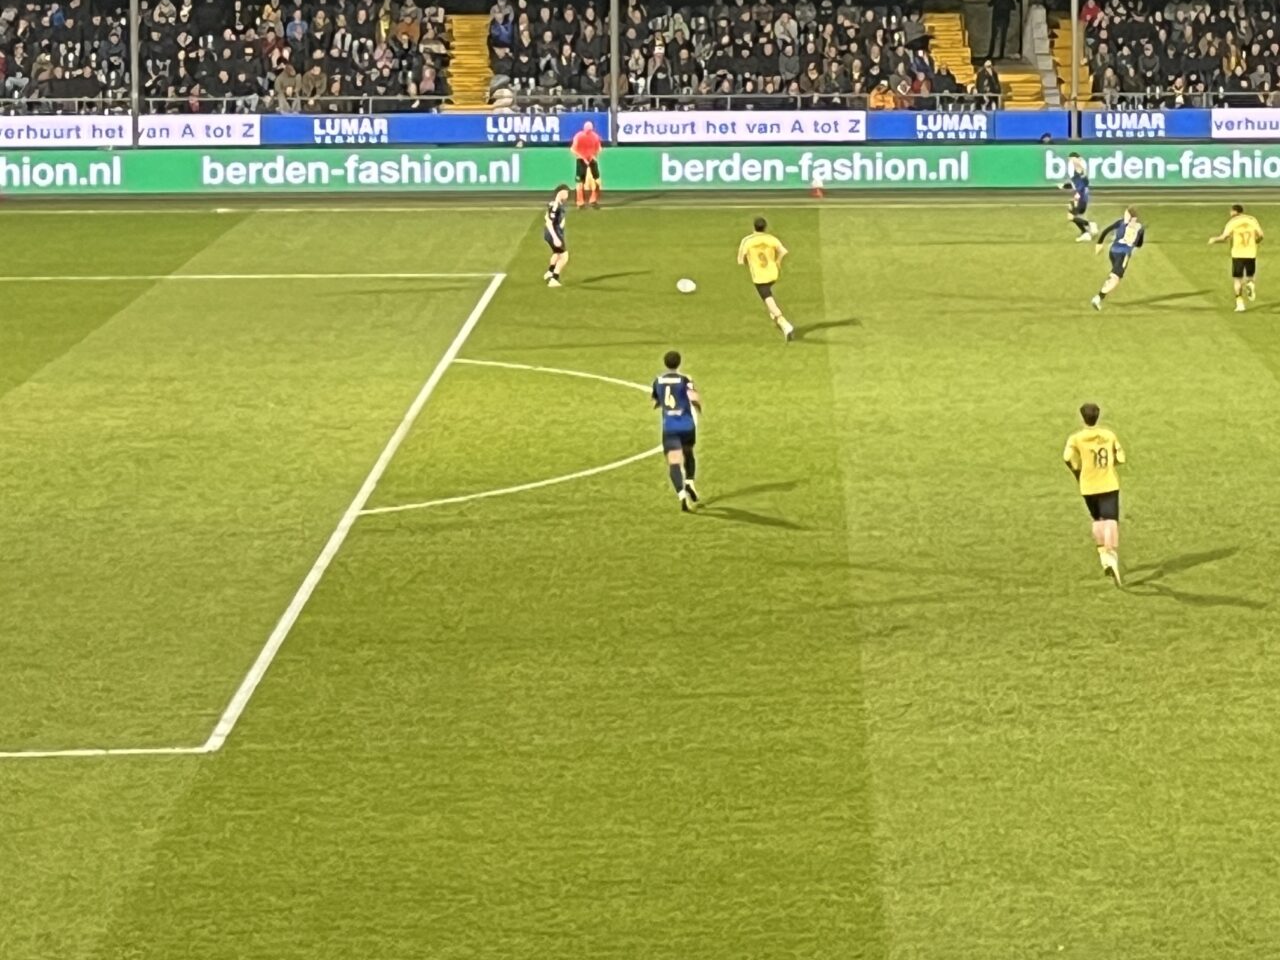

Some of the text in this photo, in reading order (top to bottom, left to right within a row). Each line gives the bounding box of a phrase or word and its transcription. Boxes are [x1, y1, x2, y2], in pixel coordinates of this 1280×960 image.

[313, 118, 388, 135] LUMAR
[486, 116, 560, 133] LUMAR
[617, 118, 860, 135] erhuurt het van A tot Z
[916, 114, 987, 131] LUMAR
[1095, 113, 1166, 129] LUMAR
[92, 124, 123, 139] het
[181, 125, 195, 137] A
[205, 125, 232, 137] tot
[243, 124, 255, 137] Z
[0, 156, 121, 186] hion.nl
[203, 153, 519, 186] berden-fashion.nl
[661, 151, 969, 183] berden-fashion.nl
